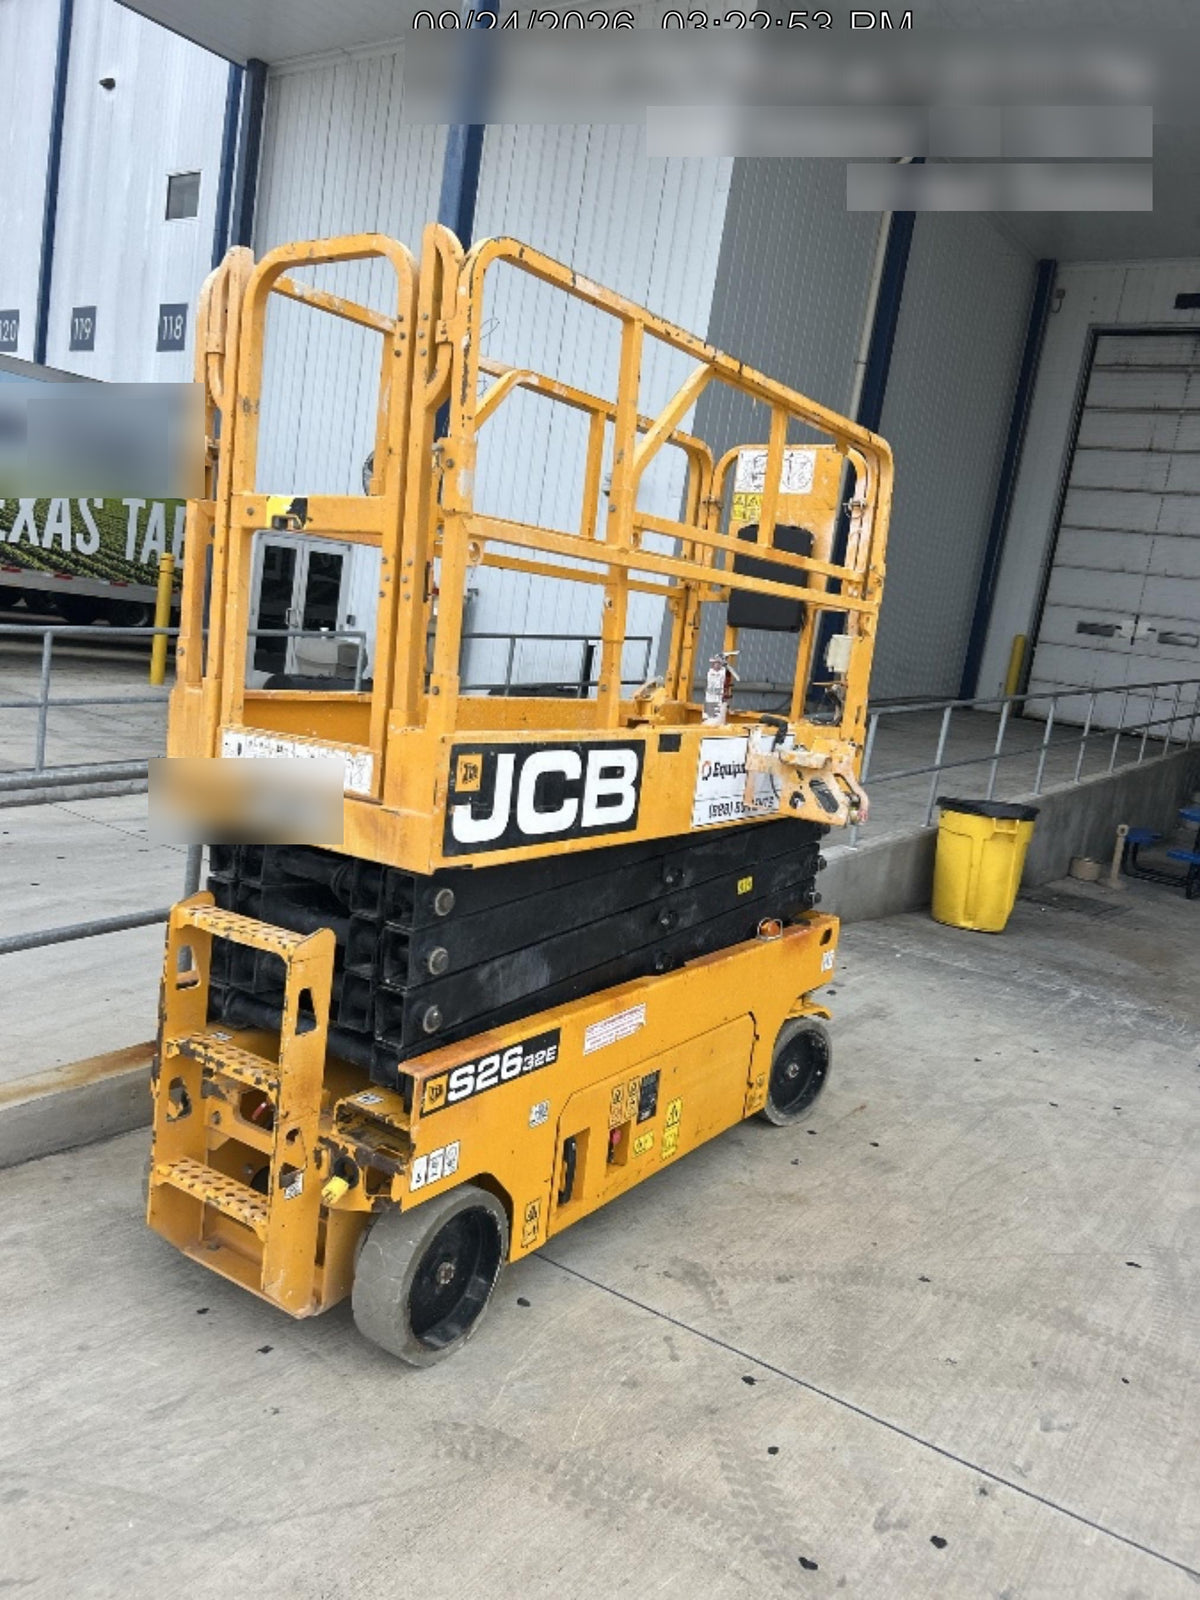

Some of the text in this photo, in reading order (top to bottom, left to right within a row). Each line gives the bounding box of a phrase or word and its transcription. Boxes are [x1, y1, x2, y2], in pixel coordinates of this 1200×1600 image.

[73, 317, 92, 340] 119
[162, 315, 184, 340] 118
[0, 498, 103, 555] XAS
[452, 749, 639, 844] JCB
[447, 1045, 523, 1102] S26
[522, 1045, 557, 1071] 32E
